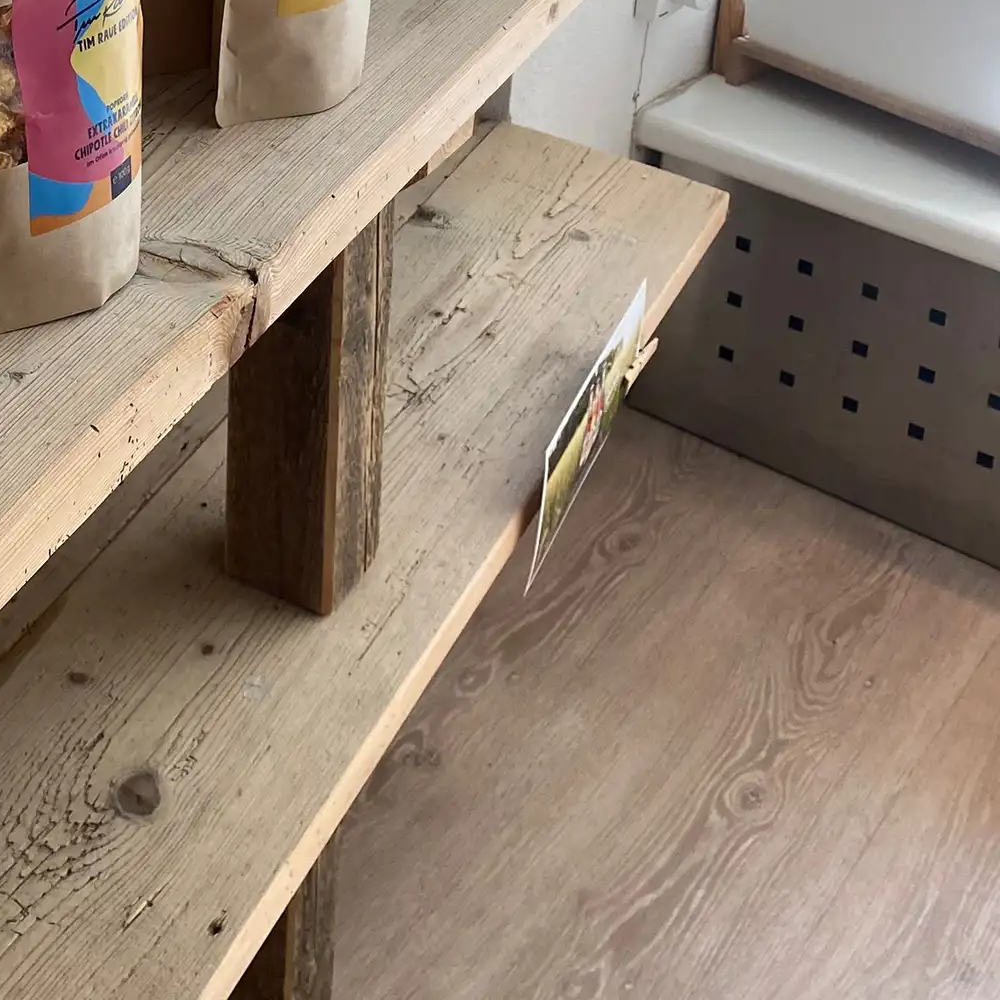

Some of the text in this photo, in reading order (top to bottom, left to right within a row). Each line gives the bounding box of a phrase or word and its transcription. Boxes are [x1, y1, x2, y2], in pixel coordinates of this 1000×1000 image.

[77, 35, 96, 53] TIM
[97, 23, 118, 45] RAUE
[74, 131, 113, 161] CHIPOTLE
